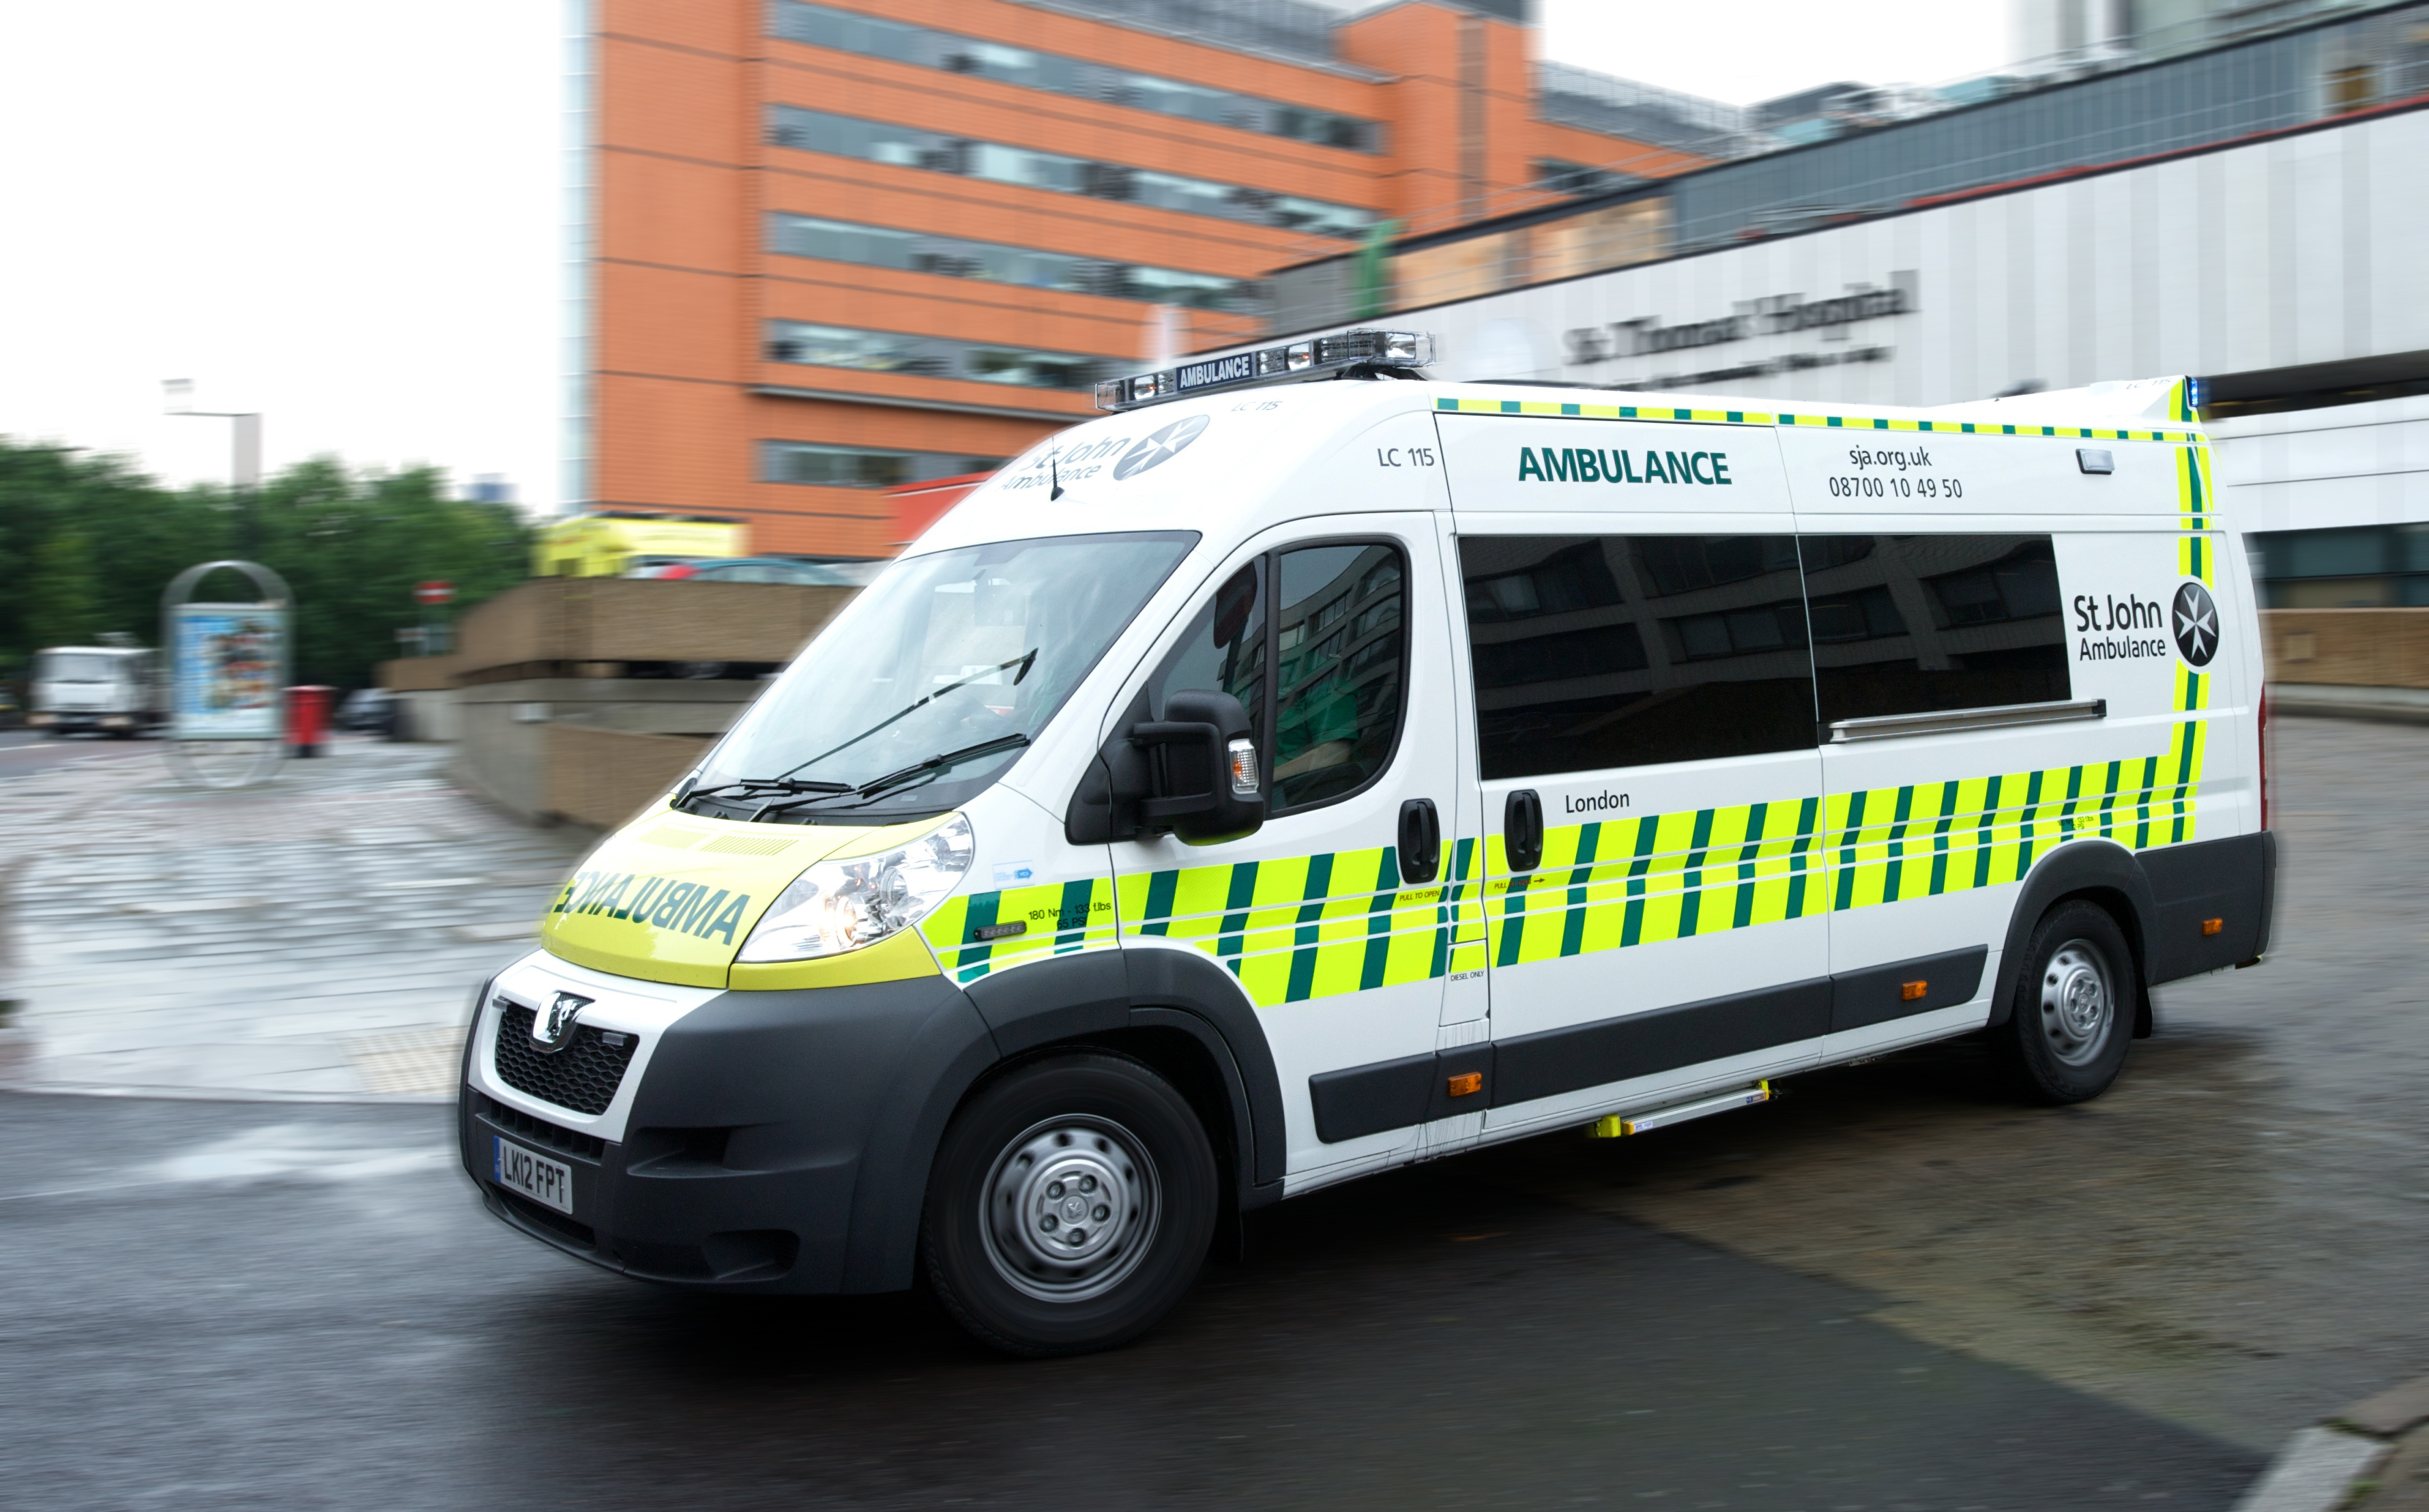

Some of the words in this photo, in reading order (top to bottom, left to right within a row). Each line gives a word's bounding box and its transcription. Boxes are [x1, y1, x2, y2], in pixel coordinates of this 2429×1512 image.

[1180, 355, 1250, 389] AMBULANCE
[1050, 435, 1132, 468] John
[1377, 448, 1401, 467] LC
[1407, 448, 1435, 467] 115
[1849, 444, 1932, 471] sja.org.uk
[1518, 447, 1732, 485] AMBULANCE
[1829, 476, 1885, 497] 08700
[1890, 478, 1911, 498] 10
[1917, 478, 1937, 498] 49
[1942, 479, 1963, 498] 50
[2073, 595, 2101, 633] St
[2106, 594, 2164, 630] John
[2079, 635, 2166, 661] Ambulance
[1565, 789, 1630, 813] London
[1028, 910, 1045, 920] 180
[1048, 908, 1064, 918] Nm
[1075, 903, 1090, 915] 133
[1057, 919, 1069, 930] 65
[1072, 916, 1088, 927] PSI
[1470, 970, 1485, 978] ONLY
[504, 1146, 533, 1191] LK12
[536, 1160, 564, 1204] FPT
